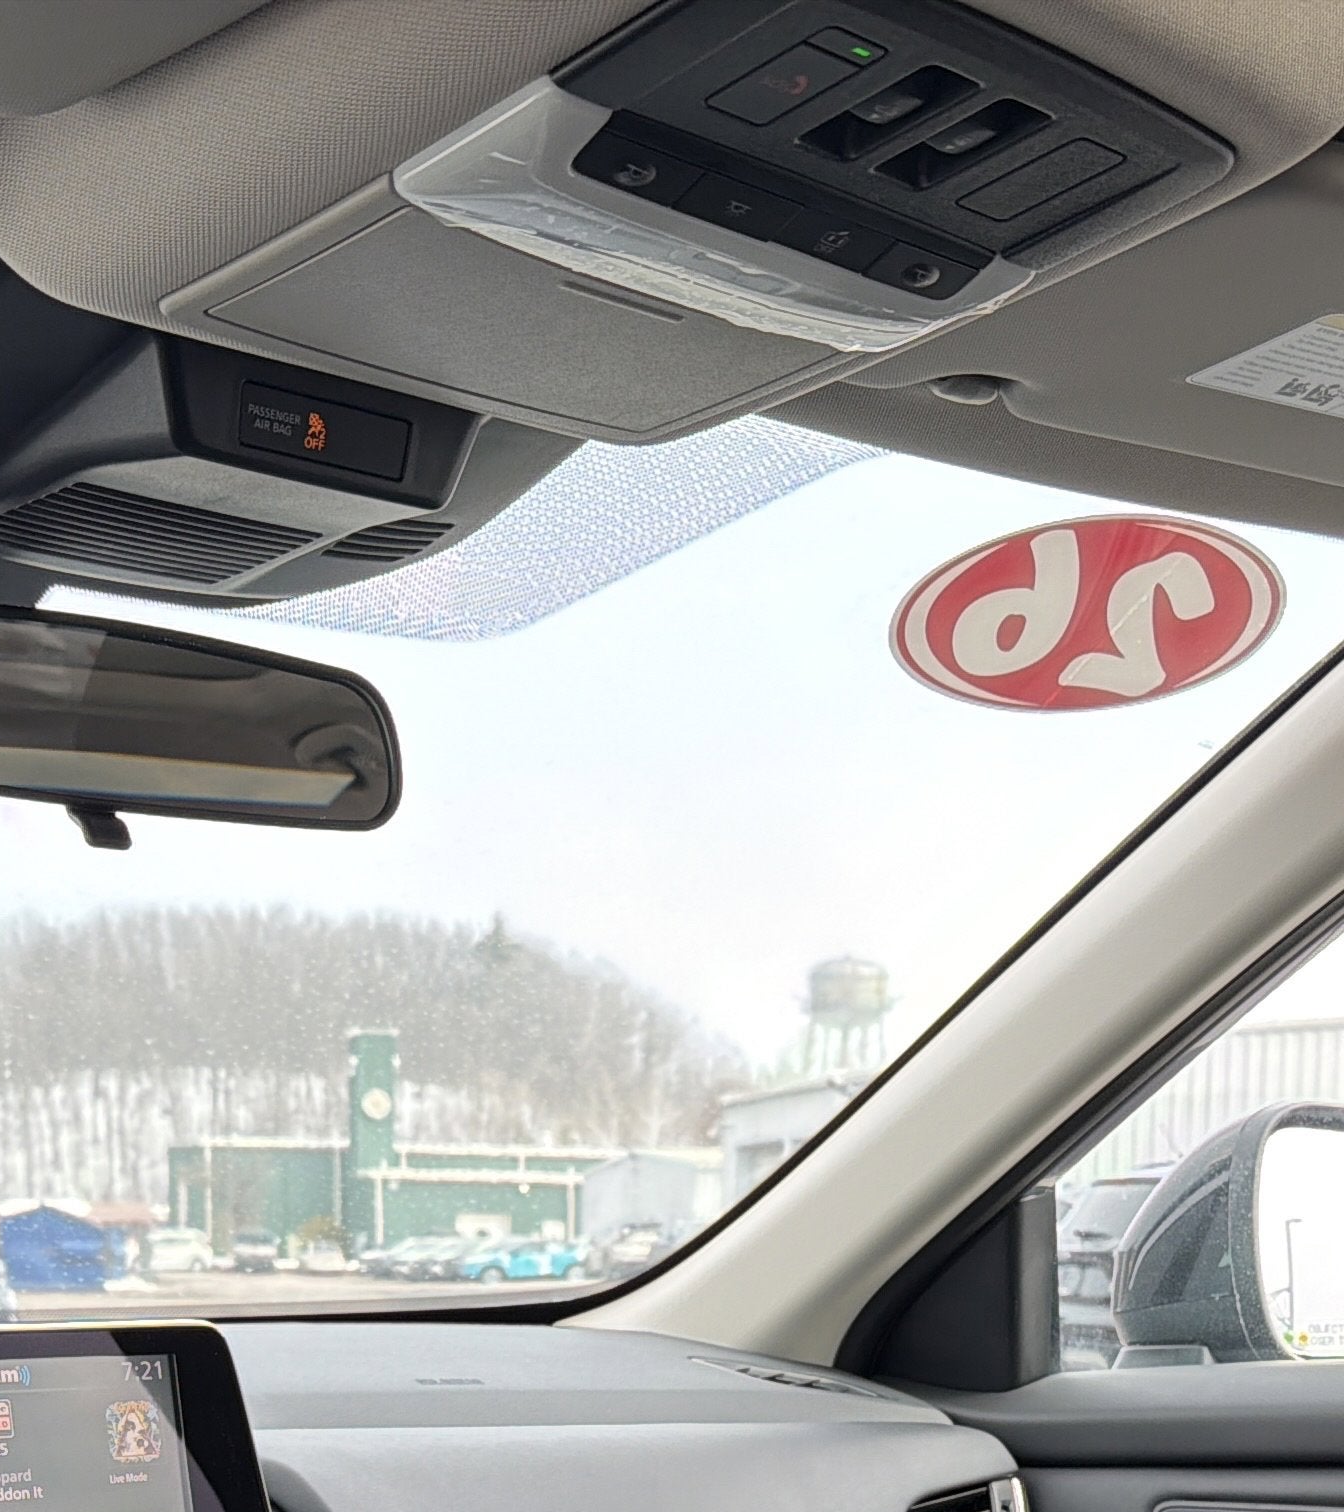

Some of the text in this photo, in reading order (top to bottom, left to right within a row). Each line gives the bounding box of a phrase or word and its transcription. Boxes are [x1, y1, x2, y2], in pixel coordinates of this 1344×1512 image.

[248, 404, 301, 425] PASSENGER
[254, 418, 292, 436] AIR BAG
[304, 437, 326, 451] OFF
[121, 1360, 162, 1381] 7:21
[109, 1472, 148, 1484] Live Mode
[34, 1486, 44, 1499] It
